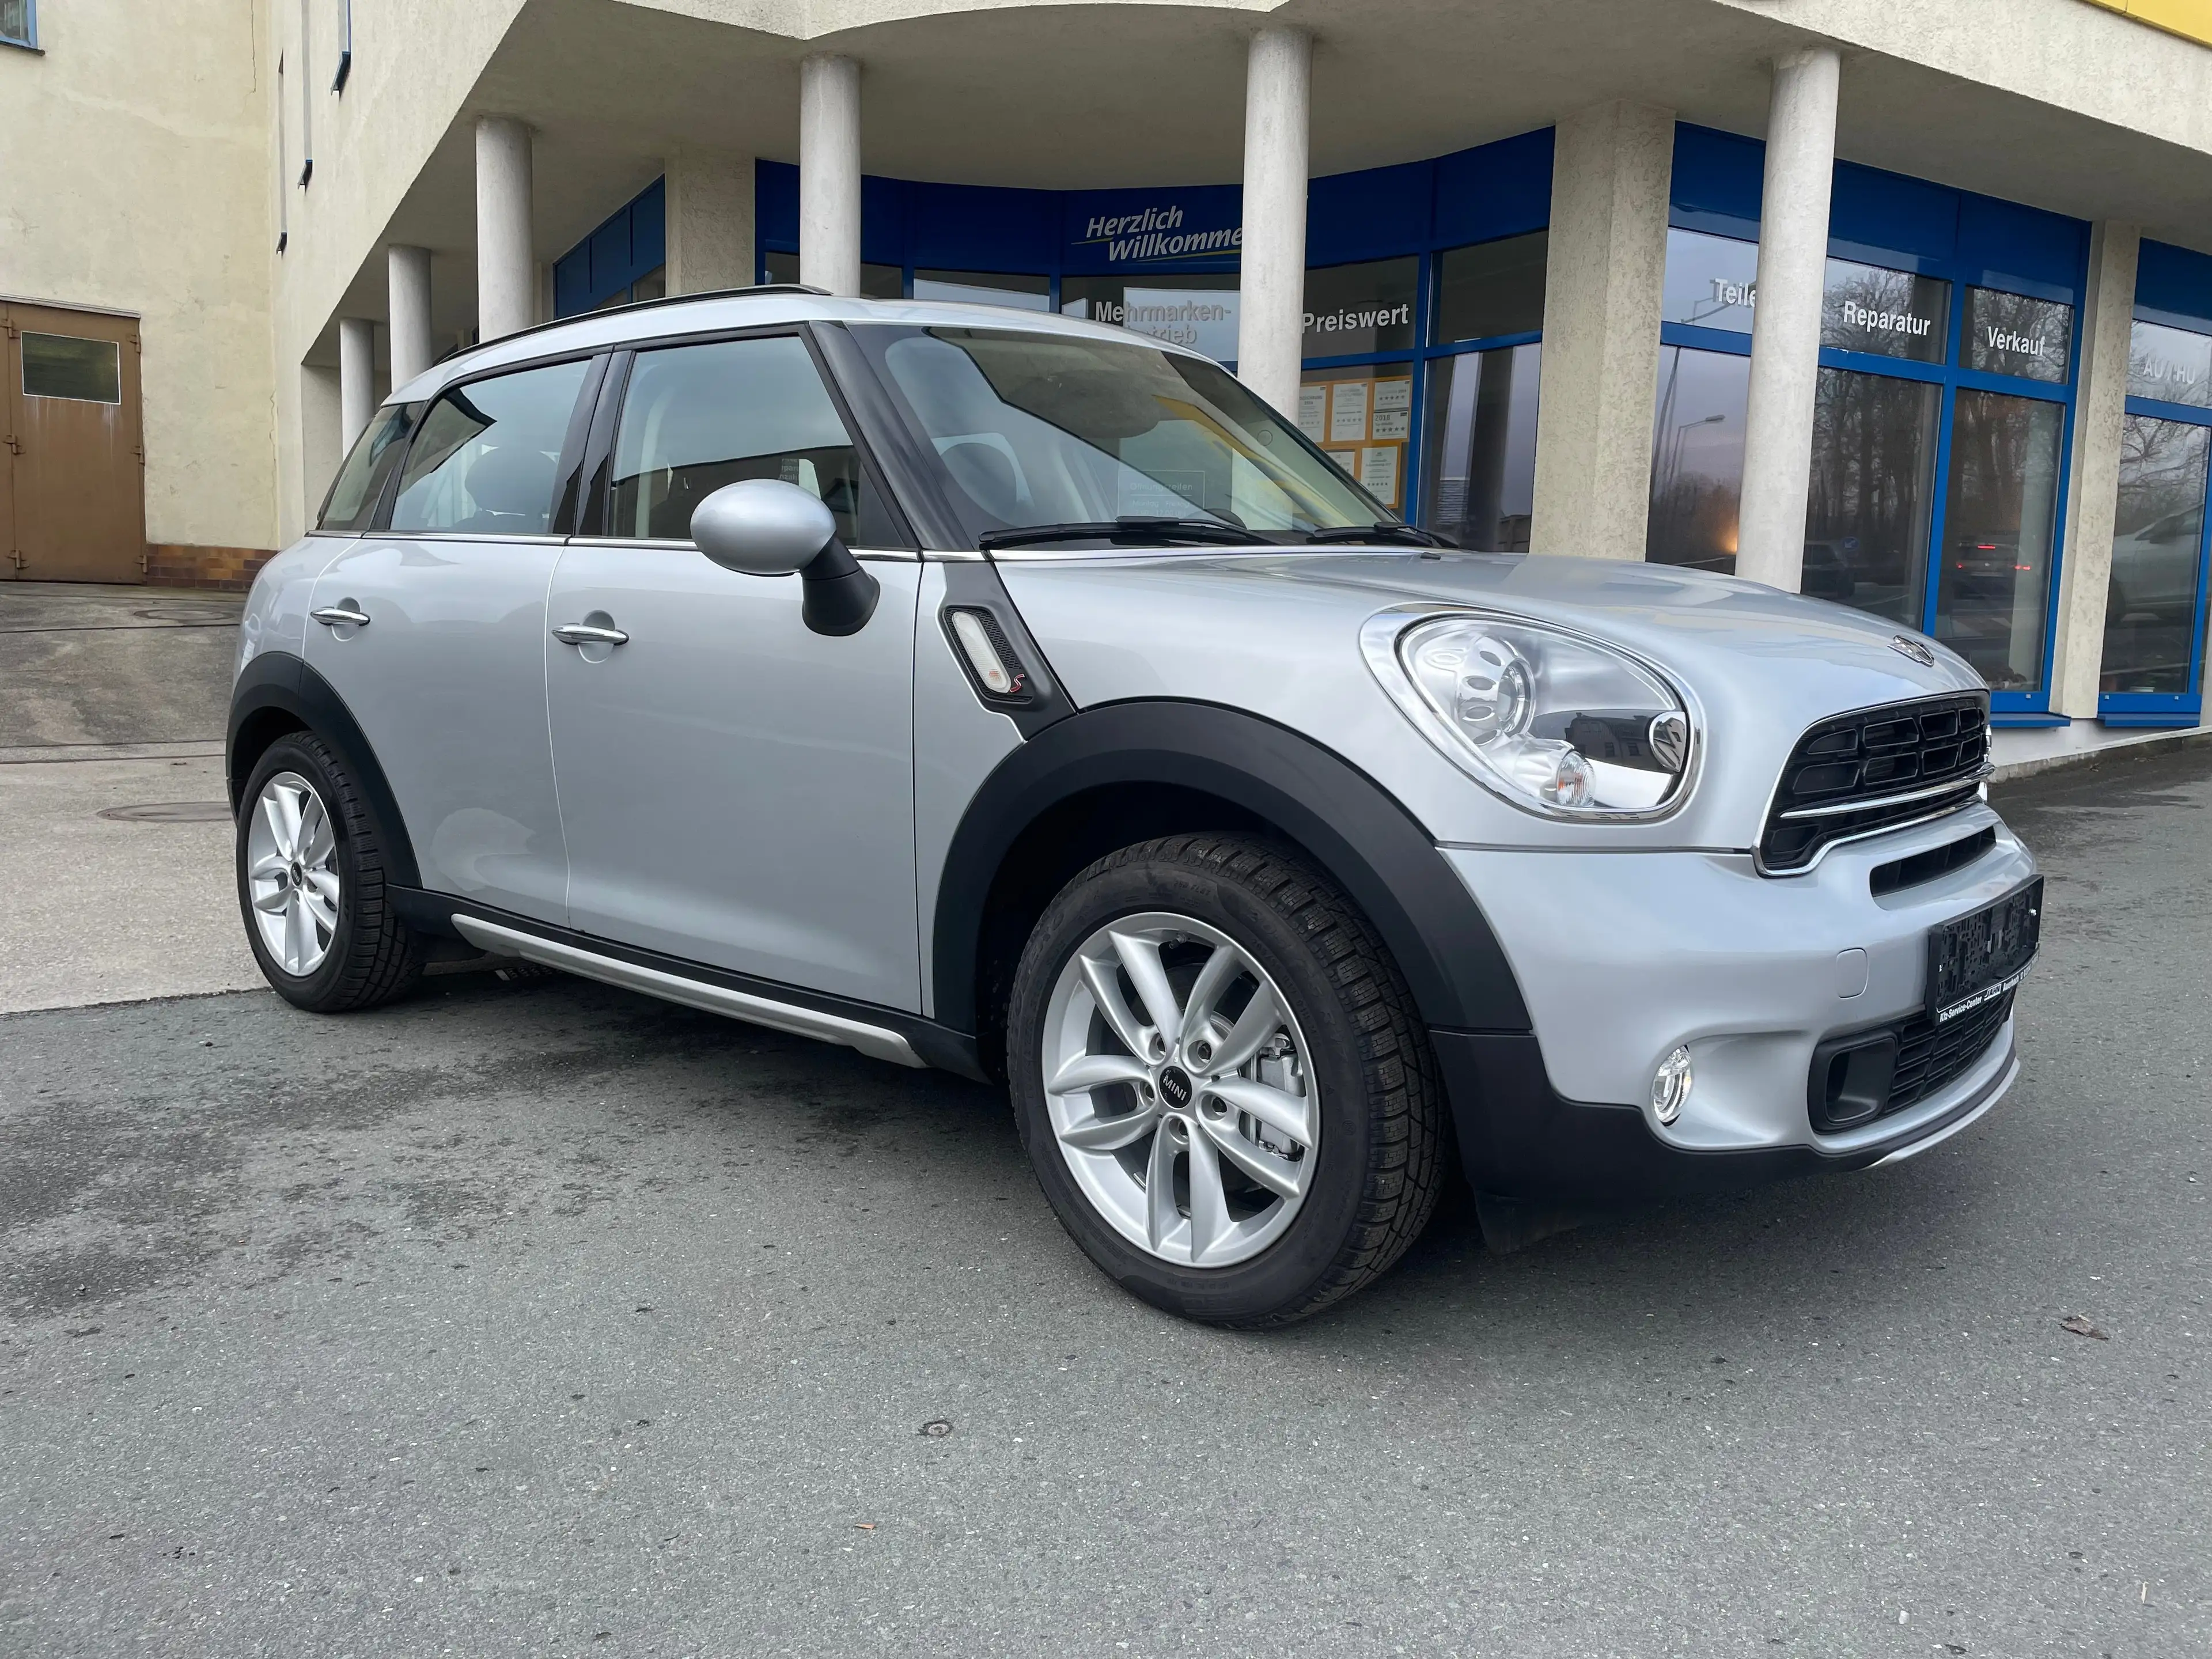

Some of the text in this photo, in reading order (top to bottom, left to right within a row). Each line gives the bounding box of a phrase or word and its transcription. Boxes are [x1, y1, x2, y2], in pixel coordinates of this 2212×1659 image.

[1086, 205, 1183, 238] Herzlich
[1095, 300, 1232, 321] Mehrmarken-
[1302, 304, 1409, 334] Preiswert
[1843, 301, 1931, 336] Reparatur
[1987, 325, 2046, 356] Verkauf
[2143, 356, 2162, 378] AU
[2176, 363, 2196, 384] HU
[1940, 996, 1982, 1022] Kfz-Service-Center
[1162, 1074, 1187, 1101] MINI
